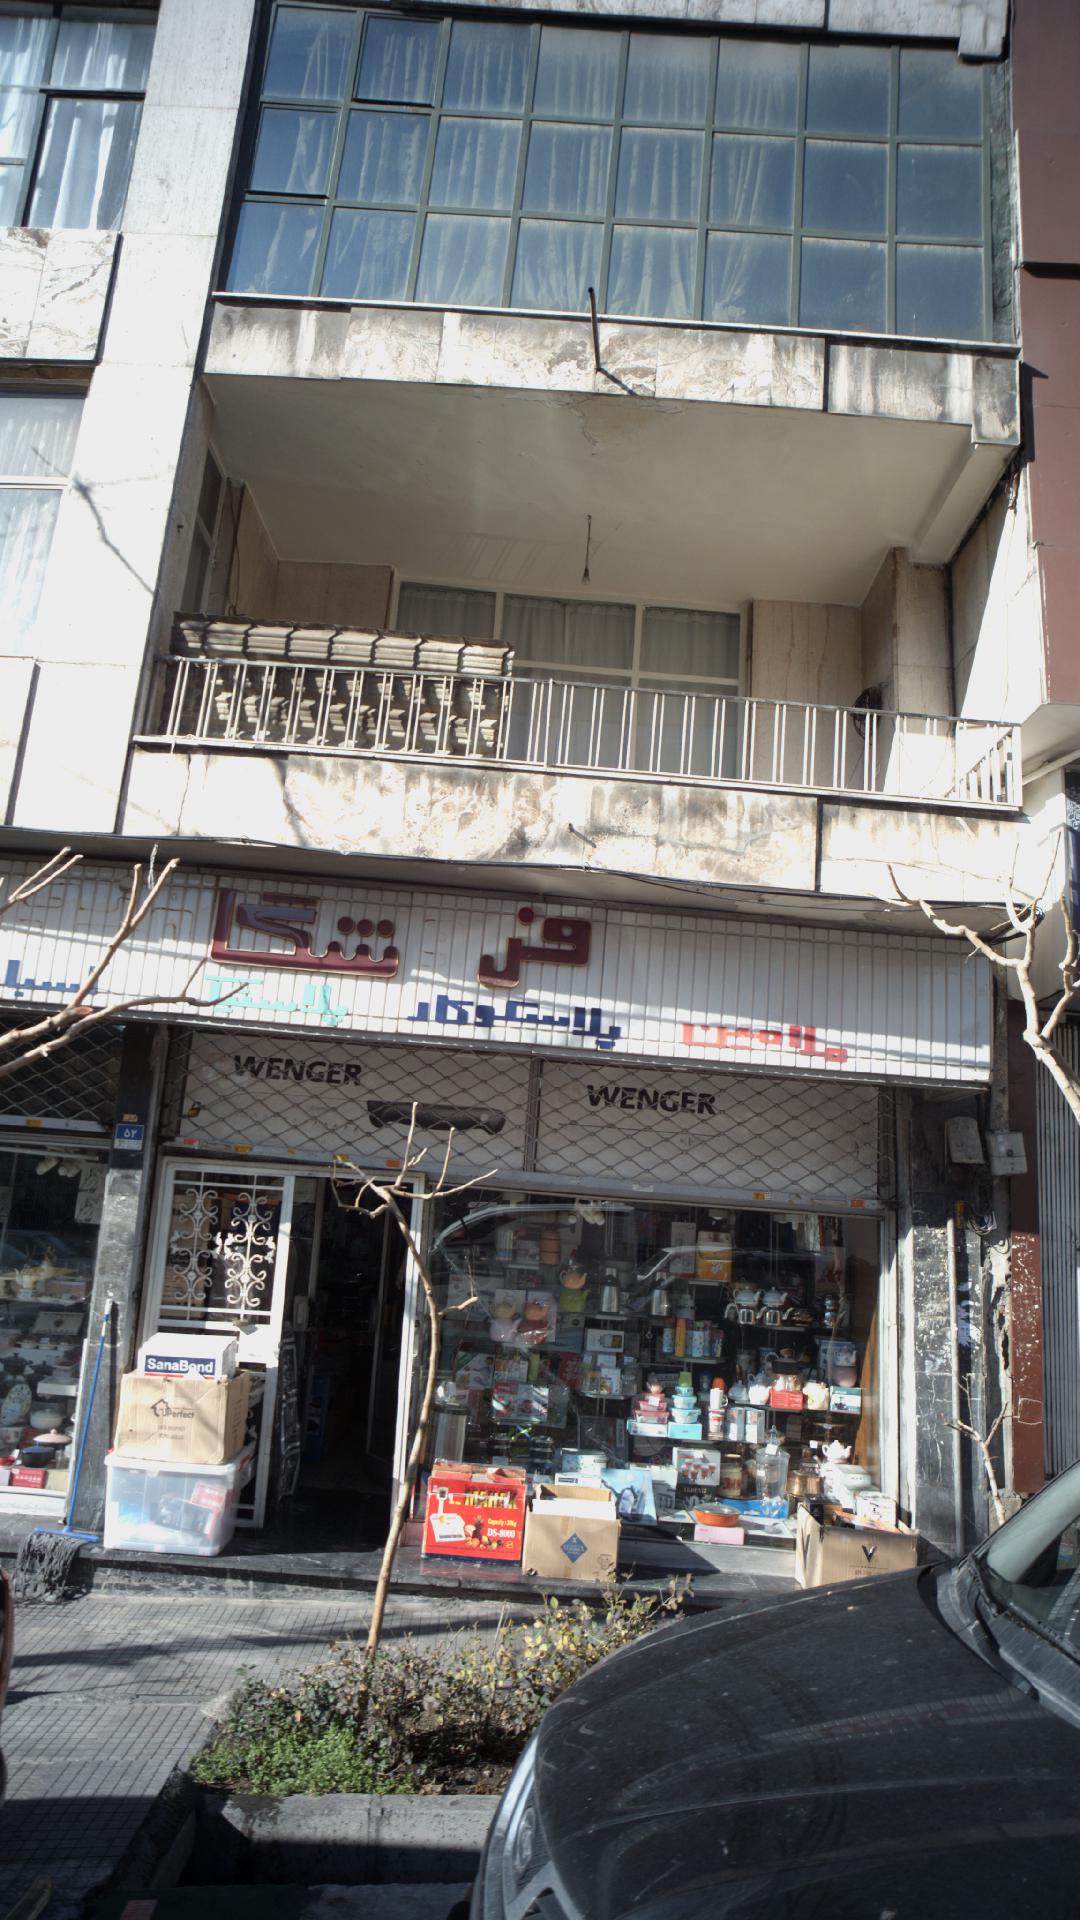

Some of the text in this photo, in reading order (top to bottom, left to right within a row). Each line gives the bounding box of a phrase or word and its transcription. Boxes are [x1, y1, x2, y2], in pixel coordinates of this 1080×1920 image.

[682, 1023, 848, 1063] ملامین
[233, 1055, 362, 1086] WENGER
[587, 1084, 717, 1116] WENGER
[147, 1358, 214, 1374] SanaBond
